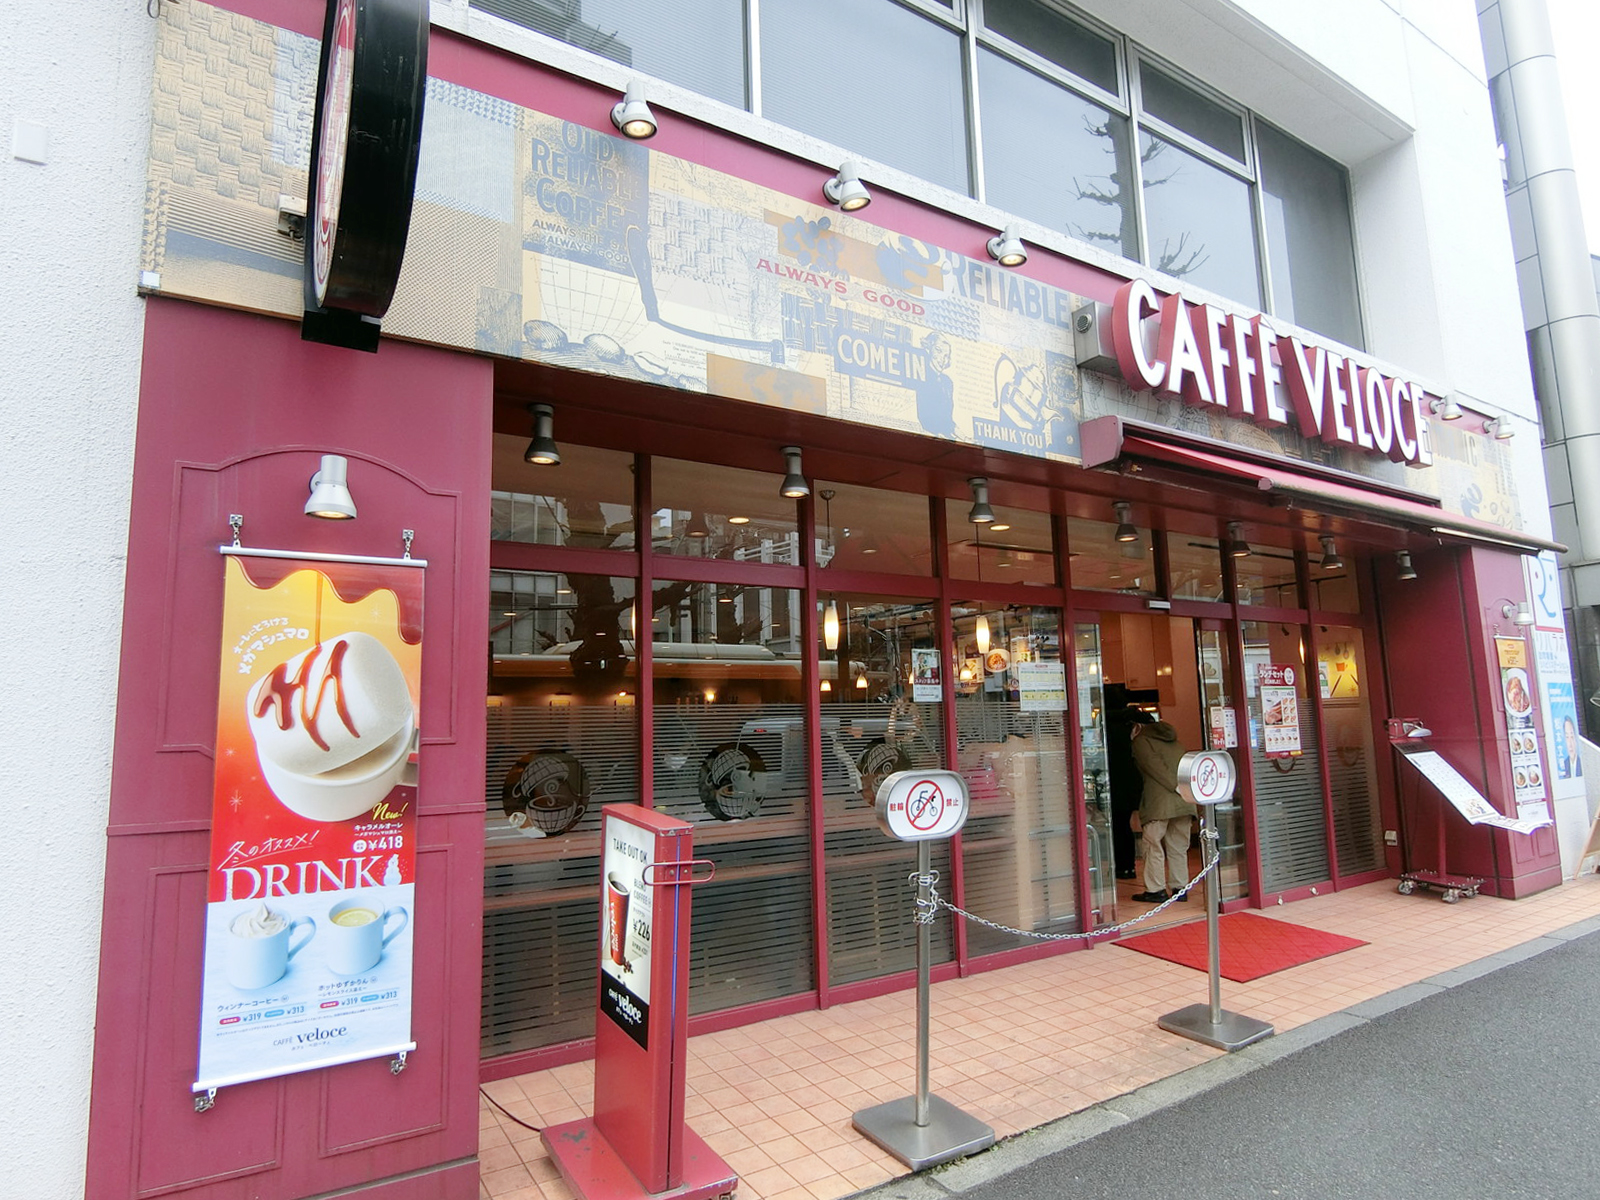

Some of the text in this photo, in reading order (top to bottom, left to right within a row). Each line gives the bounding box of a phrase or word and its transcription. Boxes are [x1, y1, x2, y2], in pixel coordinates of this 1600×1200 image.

[562, 120, 614, 161] OLD
[531, 137, 643, 200] RELIABLE
[532, 218, 577, 238] ALWAYS
[582, 231, 604, 245] THE
[547, 235, 630, 264] ALWAYS GOOD
[755, 257, 926, 317] ALWAYS GOOD
[950, 246, 1071, 330] RELIABLE
[836, 333, 900, 375] COME
[904, 350, 927, 382] IN
[1287, 336, 1433, 468] VELOCE
[975, 421, 1043, 450] THANK YOU
[238, 627, 310, 675] メガマシュマロ
[372, 801, 409, 821] New!
[368, 835, 403, 851] ¥418
[613, 837, 648, 863] TAKE OUT OK
[221, 854, 384, 901] DRINK
[217, 998, 279, 1012] ウィンナーコーヒー
[341, 996, 358, 1006] ¥319
[380, 990, 398, 1000] ¥313
[618, 993, 642, 1024] veloce
[243, 1012, 262, 1022] ¥319
[287, 1005, 305, 1015] ¥313
[297, 1026, 348, 1043] veloce
